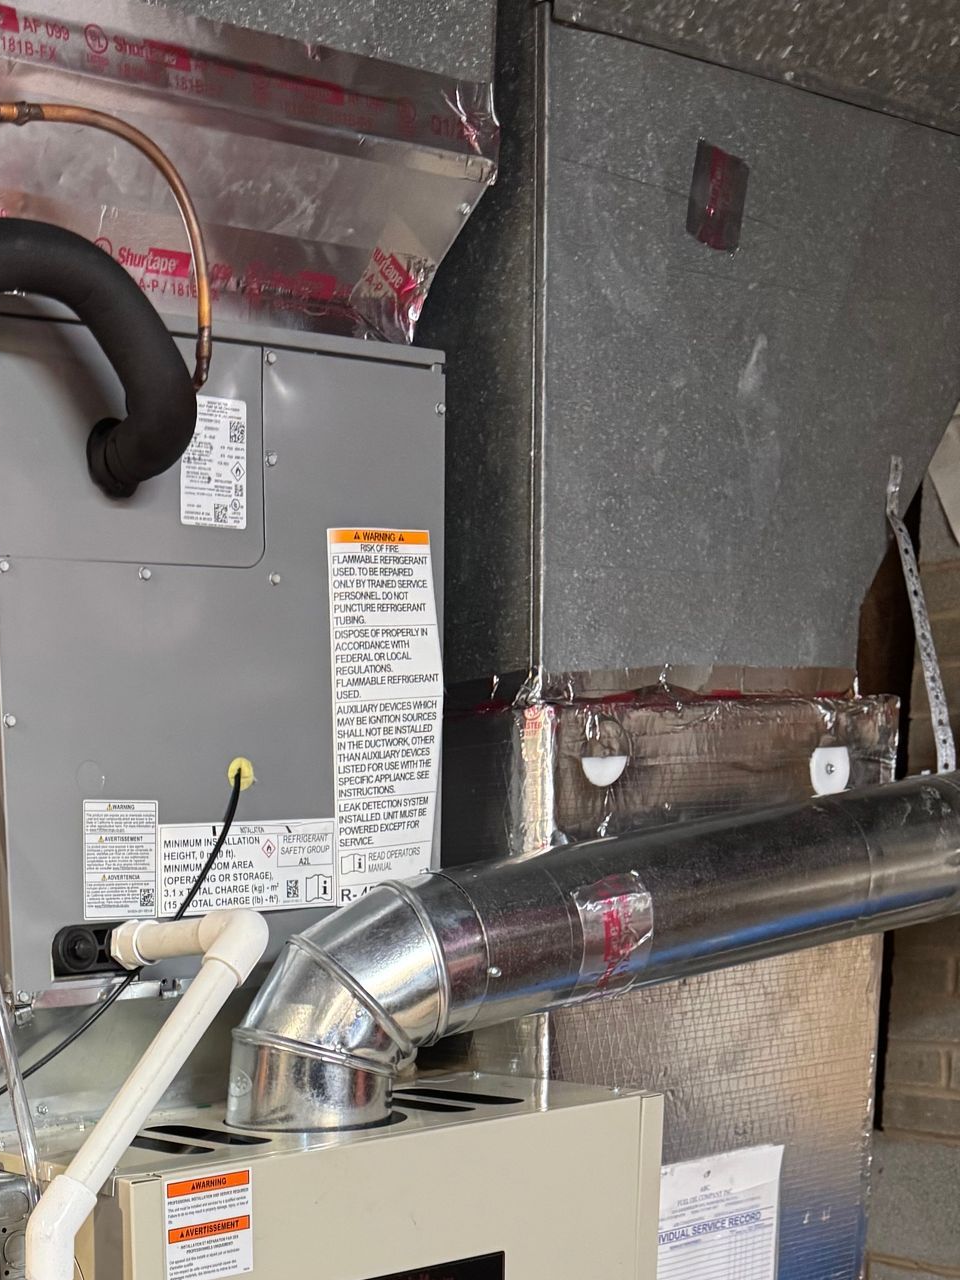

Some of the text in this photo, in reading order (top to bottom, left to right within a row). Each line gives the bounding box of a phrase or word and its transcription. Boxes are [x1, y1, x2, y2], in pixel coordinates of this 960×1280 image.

[118, 246, 176, 272] Shurtape
[363, 532, 396, 542] WARNING
[360, 544, 375, 553] RISK
[376, 544, 384, 552] OF
[332, 555, 427, 565] FLAMMABLE REFRIGERANT
[333, 568, 413, 576] USED. TO BE REPAIRED
[333, 579, 354, 589] ONLY
[356, 580, 366, 588] BY
[367, 580, 396, 588] TRAINED
[382, 592, 392, 600] DO
[394, 592, 408, 600] NOT
[334, 603, 426, 613] PUNCTURE REFRIGERANT
[334, 616, 366, 626] TUBING.
[335, 628, 428, 639] DISPOSE OF PROPERLY IN
[335, 640, 410, 651] ACCORDANCE WITH
[336, 652, 411, 664] FEDERAL OR LOCAL
[336, 664, 393, 676] REGULATIONS.
[336, 674, 439, 688] FLAMMABLE REFRIGERANT
[336, 690, 361, 700] USED.
[337, 700, 437, 715] AUXILIARY DEVICES WHICH
[337, 712, 436, 727] MAY BE IGNITION SOURCES
[337, 724, 432, 738] SHALL NOT BE INSTALLED
[338, 742, 346, 751] IN
[348, 740, 363, 750] THE
[411, 736, 435, 745] OTHER
[338, 747, 430, 763] THAN AUXILIARY DEVICES
[338, 759, 432, 774] LISTED FOR USE WITH THE
[338, 775, 374, 786] SPECIFIC
[417, 771, 429, 779] SEE
[339, 786, 395, 798] INSTRUCTIONS.
[339, 796, 428, 812] LEAK DETECTION SYSTEM
[383, 811, 398, 820] UNIT
[400, 810, 417, 820] MUST
[418, 808, 427, 816] BE
[340, 820, 420, 836] POWERED EXCEPT FOR
[163, 837, 260, 848] MINIMUM INSALLATION
[283, 834, 328, 844] REFRIGERANT
[164, 852, 198, 861] HEIGHT,
[281, 846, 330, 855] SAFETY GROUP
[368, 847, 420, 861] READ OPERATORS
[164, 861, 254, 872] MINIMUM OOM AREA
[368, 862, 392, 872] MANUAL
[163, 876, 216, 886] (OPERANG
[218, 874, 230, 882] OR
[164, 889, 176, 897] 3.1
[186, 887, 212, 896] TTAL
[215, 884, 250, 894] CHARGE
[252, 883, 265, 893] (kg)
[163, 901, 177, 911] (15
[191, 898, 217, 908] OTAL
[218, 896, 250, 906] CHARGE
[252, 896, 263, 905] (lb)
[195, 1177, 227, 1190] WARNING
[185, 1220, 240, 1237] AVERTISSEMENT
[659, 1211, 761, 1243] IVIDUAL SERVICE RECORD
